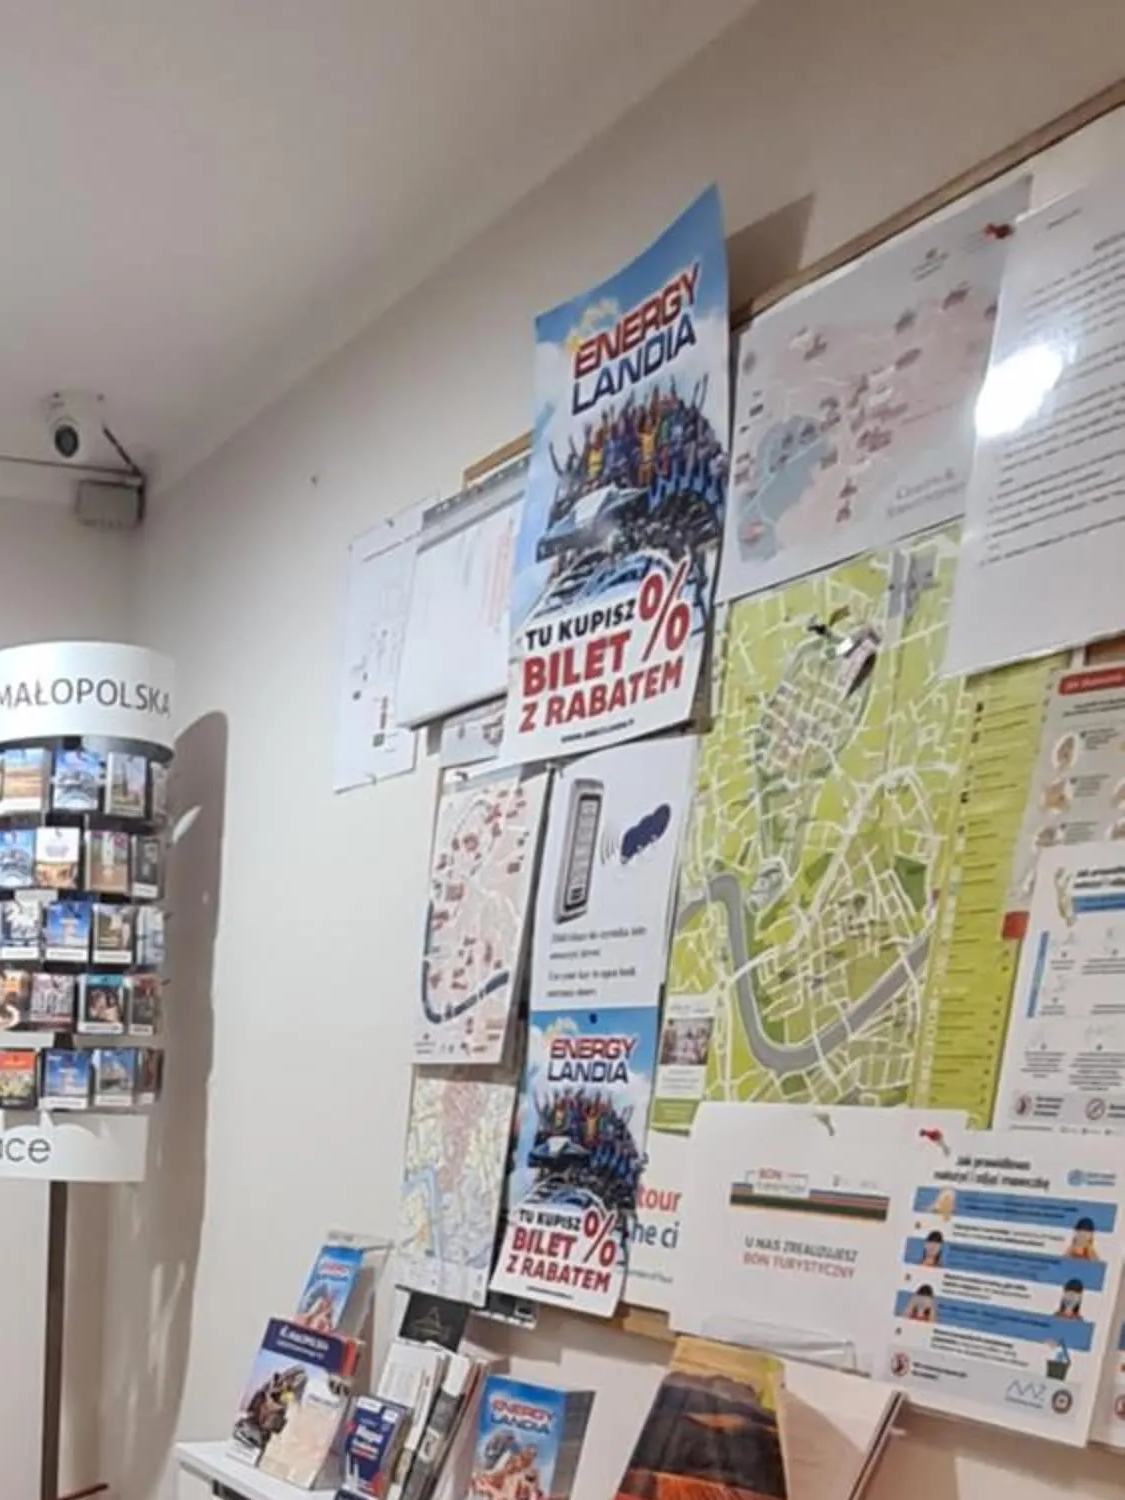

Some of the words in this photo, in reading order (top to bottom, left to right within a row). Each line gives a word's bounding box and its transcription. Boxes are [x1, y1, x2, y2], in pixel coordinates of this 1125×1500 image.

[573, 259, 700, 380] ENERGY
[572, 312, 697, 417] LANDIA
[525, 623, 553, 651] TU
[558, 598, 637, 643] KUPISZ
[523, 628, 632, 698] BILET
[519, 701, 539, 734] Z
[544, 655, 684, 728] RABATEM
[547, 1060, 629, 1084] LANDIA
[550, 1037, 637, 1060] ENERGY
[511, 1227, 578, 1261] BILET
[505, 1254, 519, 1274] Z
[520, 1256, 613, 1294] RABATEM
